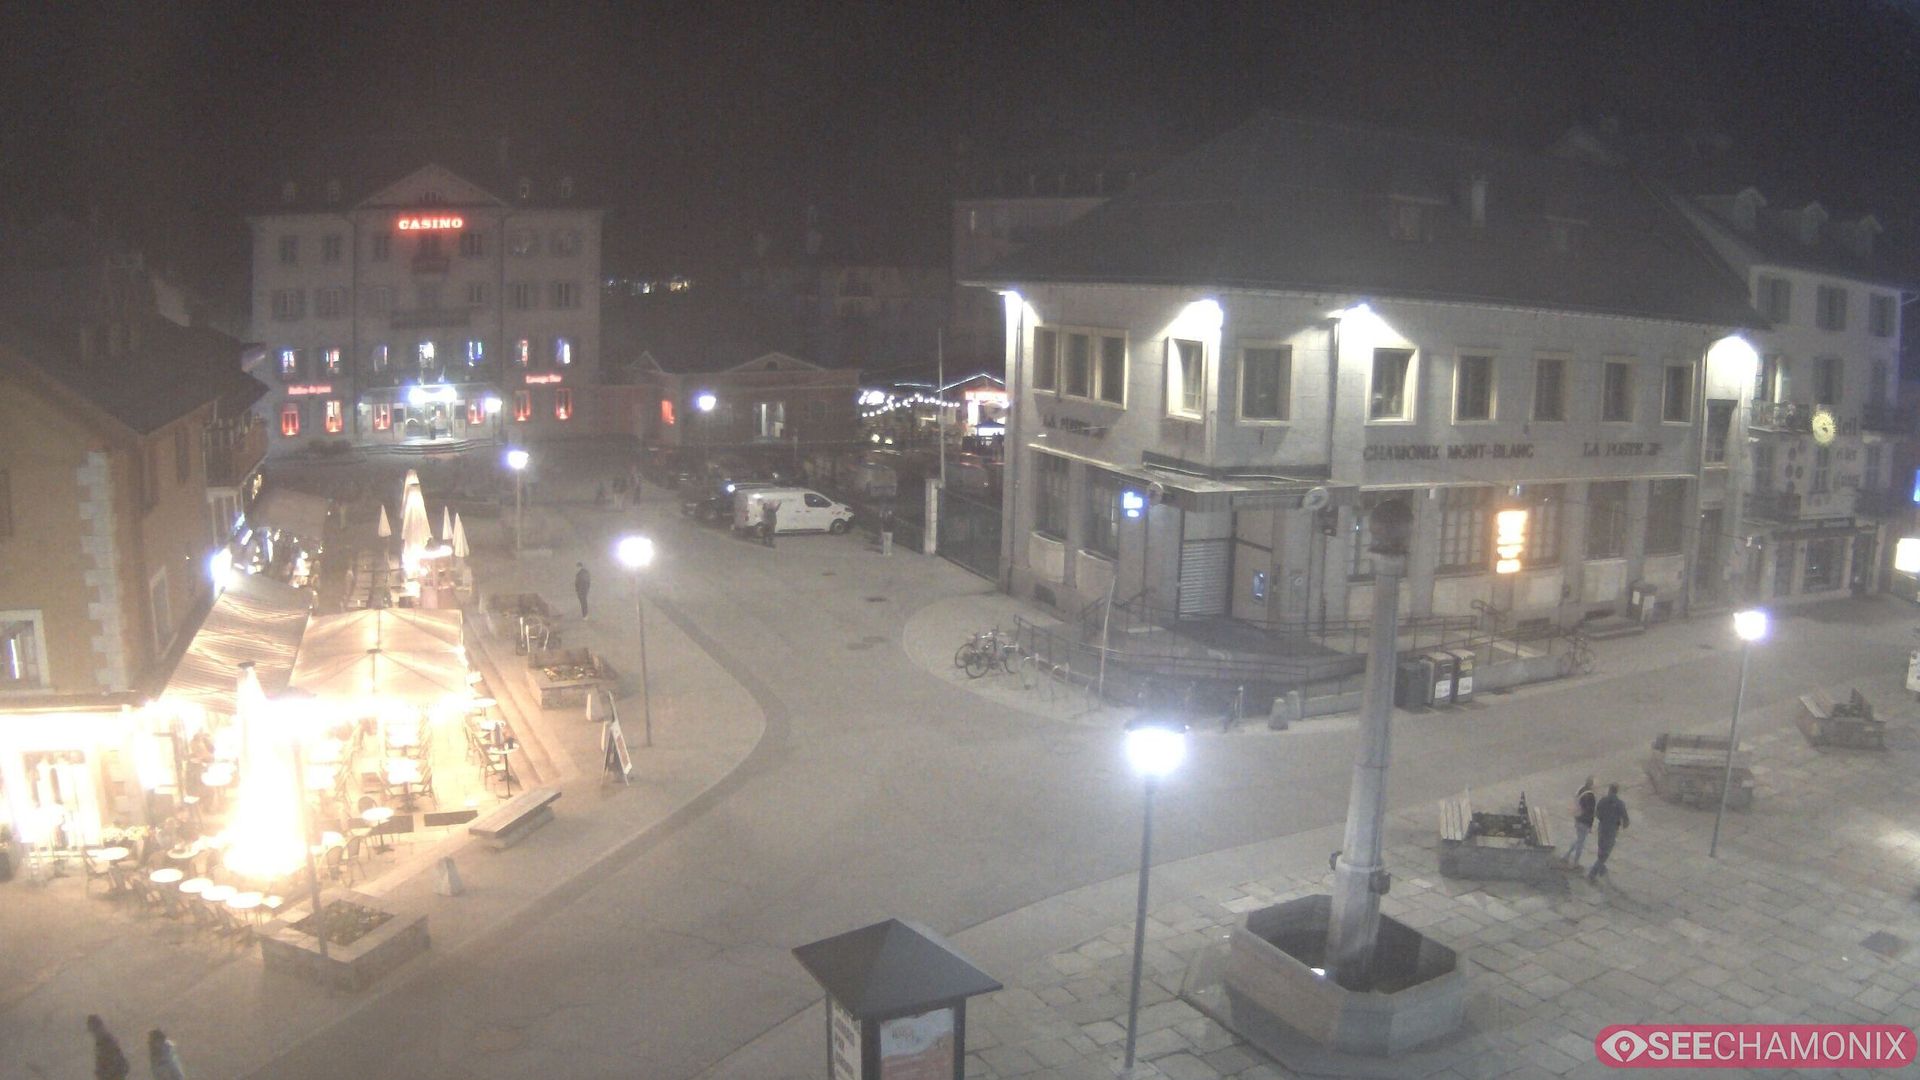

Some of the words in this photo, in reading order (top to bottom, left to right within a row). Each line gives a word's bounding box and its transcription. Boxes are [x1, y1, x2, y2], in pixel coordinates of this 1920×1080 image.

[398, 216, 463, 230] CASINO
[1363, 444, 1440, 461] CHAMONIX
[1447, 443, 1534, 460] MONT-BLANC
[1583, 442, 1599, 456] LA
[1605, 442, 1643, 456] POSTE
